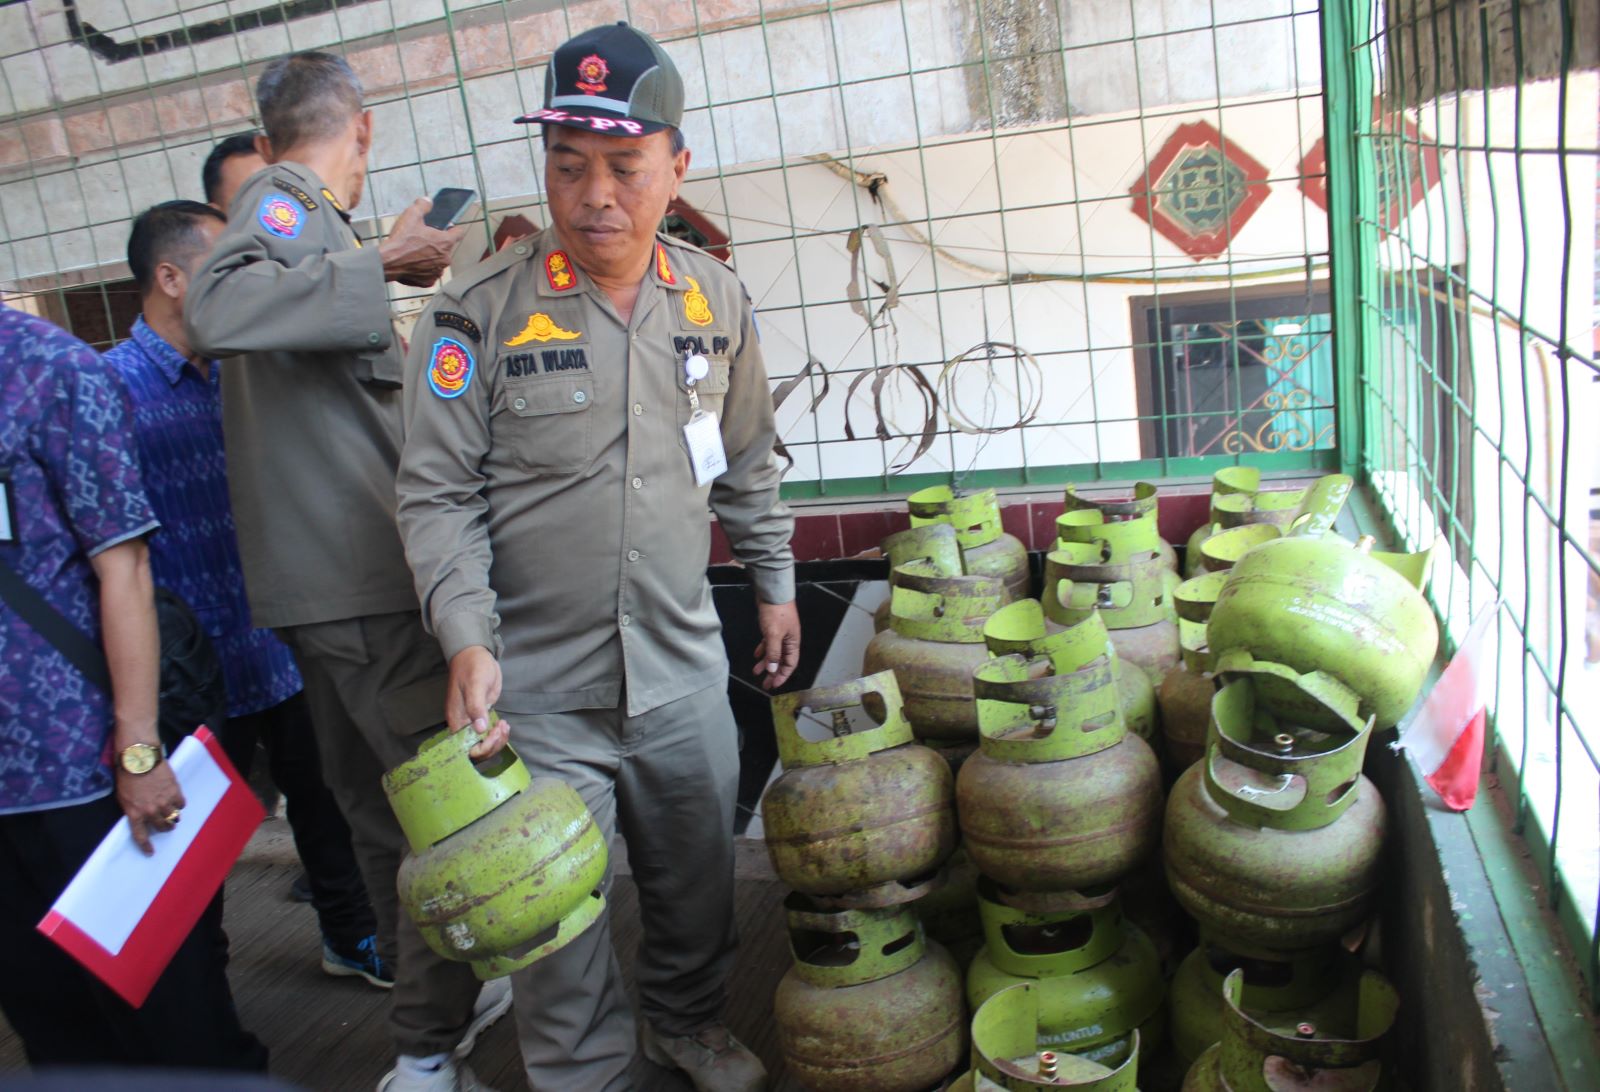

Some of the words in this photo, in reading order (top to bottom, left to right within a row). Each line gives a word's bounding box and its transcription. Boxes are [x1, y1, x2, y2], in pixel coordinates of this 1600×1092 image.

[524, 109, 643, 134] OL-PP
[673, 335, 709, 355] POL
[713, 335, 729, 355] PP
[506, 353, 538, 377] ASTA
[541, 348, 588, 373] WIJAYA
